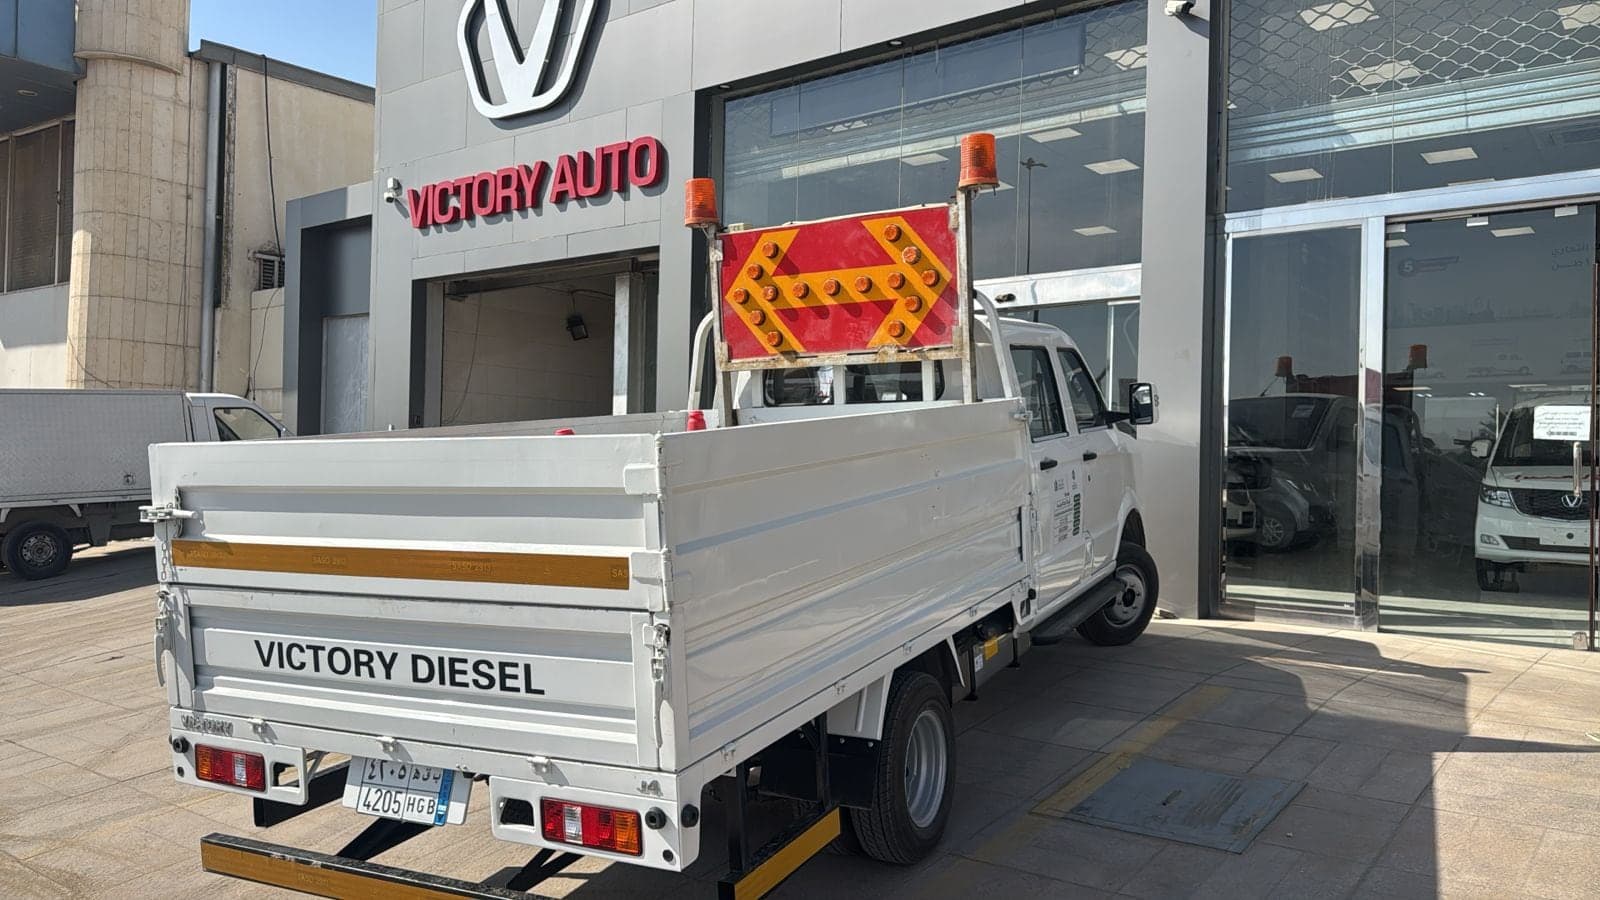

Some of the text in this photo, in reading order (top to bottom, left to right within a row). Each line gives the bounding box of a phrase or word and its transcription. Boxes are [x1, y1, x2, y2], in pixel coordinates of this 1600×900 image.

[407, 135, 663, 229] VICTORY AUTO
[254, 639, 545, 695] VICTORY DIESEL
[362, 787, 436, 815] 4205 HGB
